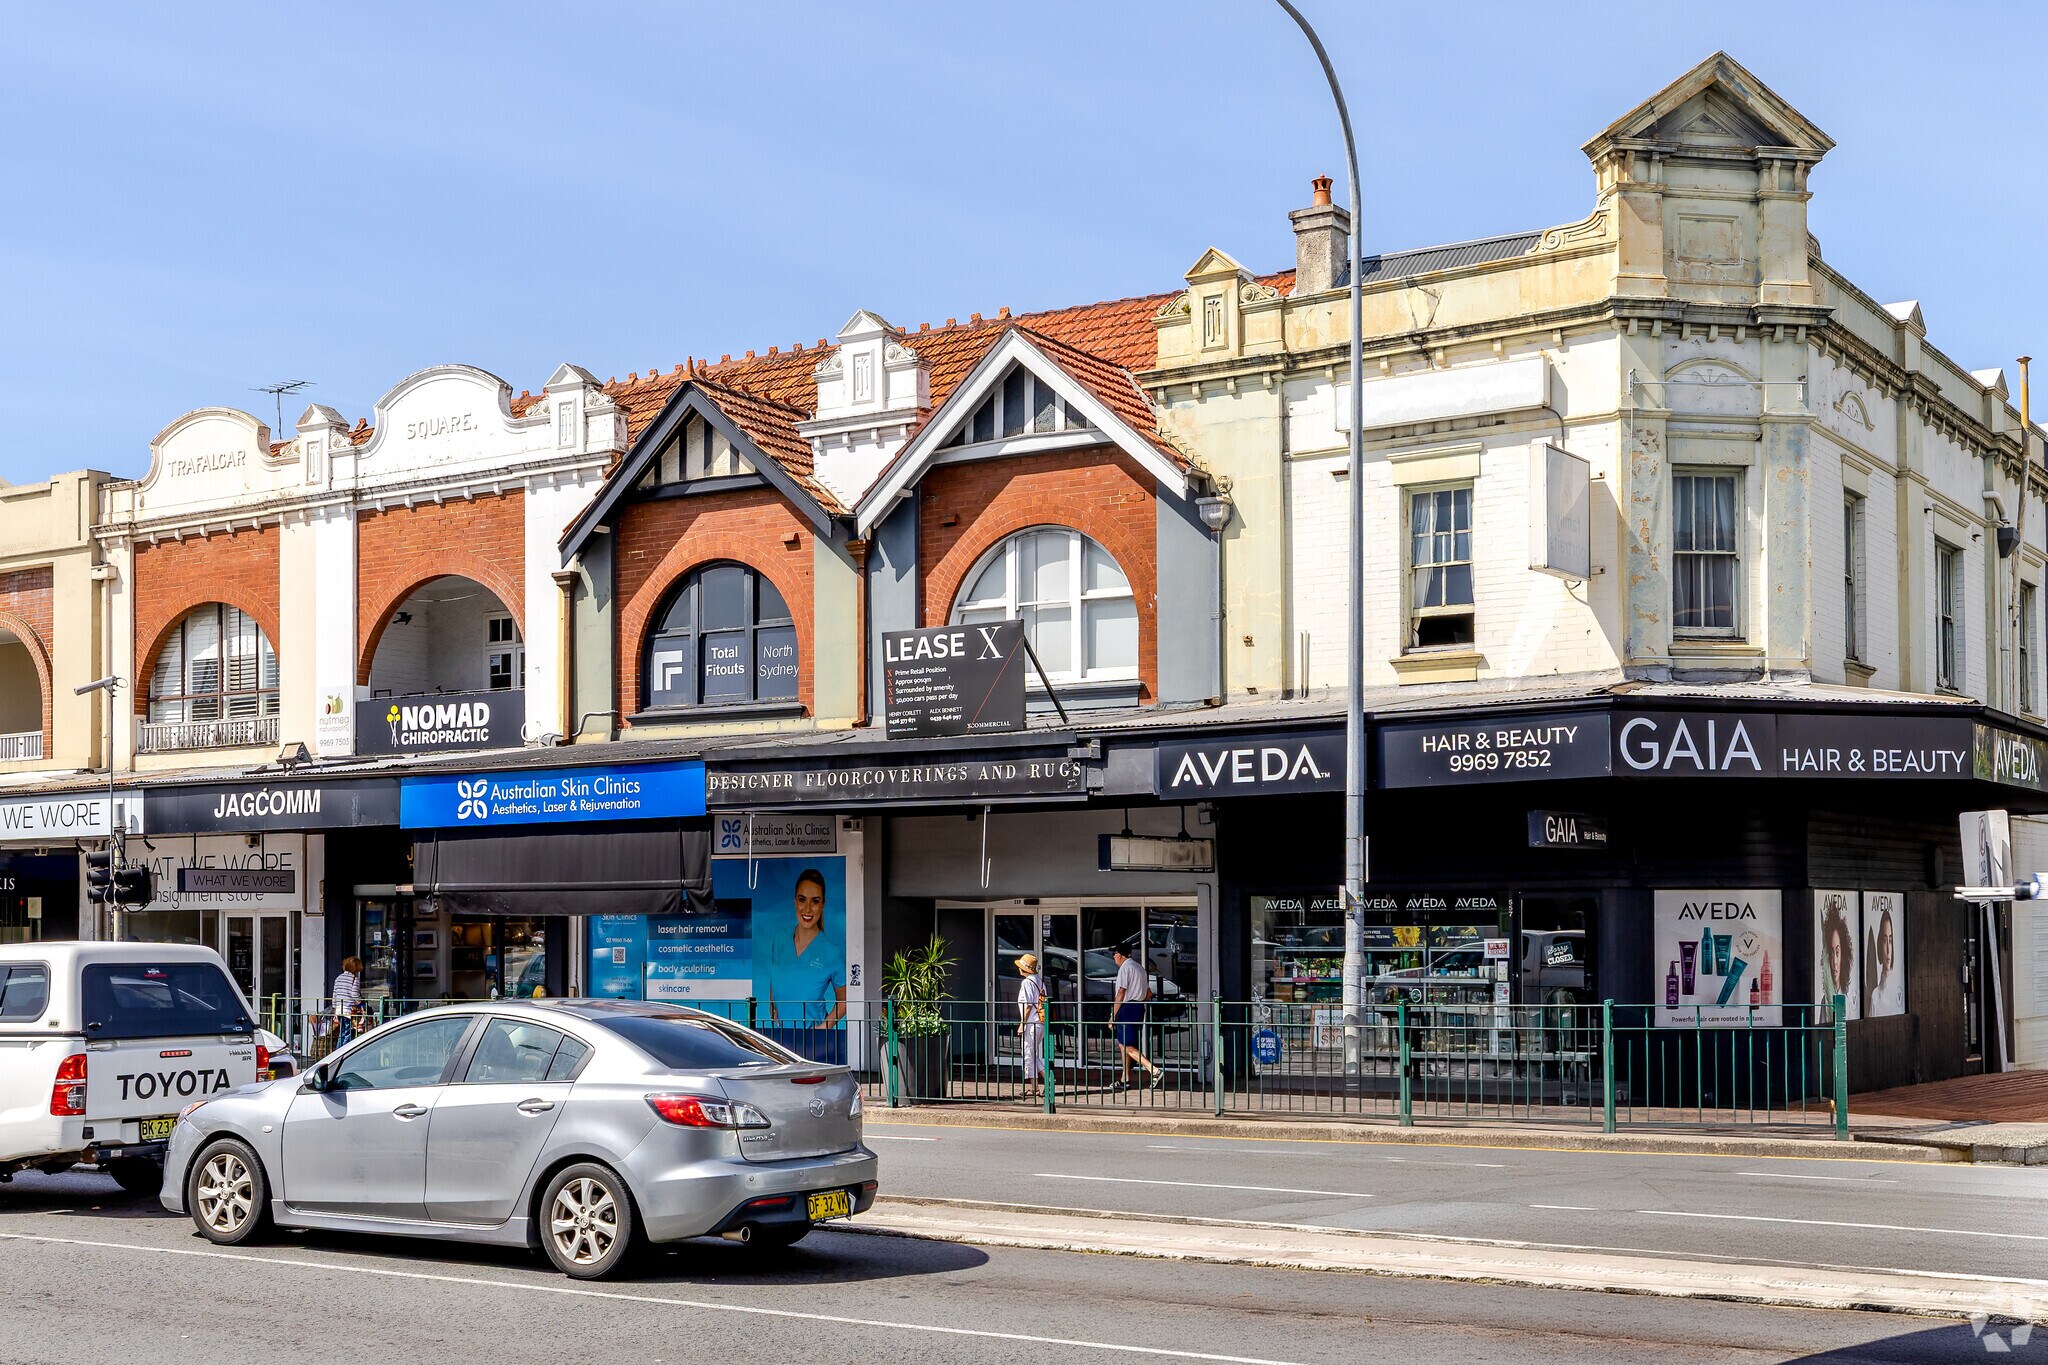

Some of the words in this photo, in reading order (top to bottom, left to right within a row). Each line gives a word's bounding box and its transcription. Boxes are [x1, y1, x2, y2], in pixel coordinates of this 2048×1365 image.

[168, 449, 247, 477] TRAFALGAR
[885, 632, 966, 663] LEASE
[976, 625, 1004, 661] X
[711, 646, 738, 659] Total
[763, 645, 793, 658] North
[706, 664, 745, 676] Fitouts
[759, 664, 799, 679] Sydney
[926, 666, 947, 674] Position
[895, 686, 925, 694] Surrounded
[926, 685, 933, 693] by
[319, 715, 350, 725] nutmeg
[401, 702, 490, 731] NOMAD
[319, 738, 335, 747] 9969
[400, 727, 490, 746] CHIROPRACTIC
[1422, 735, 1471, 753] HAIR
[1476, 732, 1490, 750] &
[1496, 726, 1578, 749] BEAUTY
[1619, 717, 1762, 771] GAIA
[1782, 747, 1842, 772] HAIR
[1847, 748, 1866, 771] &
[1874, 749, 1966, 773] BEAUTY
[1450, 751, 1500, 772] 9969
[1502, 748, 1552, 770] 7852
[709, 773, 794, 791] DESIGNER
[804, 766, 968, 788] FLOORCOVERINGS
[978, 764, 1017, 781] AND
[1029, 761, 1082, 779] RUGS
[490, 780, 556, 800] Australian
[561, 777, 589, 797] Skin
[593, 776, 641, 795] Clinics
[492, 801, 541, 815] Aesthetics,
[543, 801, 568, 813] Laser
[569, 800, 578, 811] &
[580, 798, 641, 813] Rejuvenation
[2, 804, 34, 829] WE
[40, 801, 101, 827] WORE
[785, 823, 802, 836] Skin
[803, 823, 830, 836] Clinics
[1545, 816, 1578, 843] GAIA
[775, 838, 790, 846] Laser
[797, 838, 831, 847] Rejuvenation
[223, 853, 293, 870] WORE
[0, 877, 16, 891] IS
[193, 875, 228, 887] WHAT
[230, 875, 250, 887] WE
[252, 876, 288, 887] WORE
[151, 886, 223, 909] nsignment
[1310, 899, 1340, 909] AVED
[1406, 898, 1447, 908] AVEDA
[1454, 897, 1497, 908] AVEDA
[1871, 895, 1894, 912] AVEDA
[1264, 899, 1303, 910] AVEDA
[1678, 902, 1757, 920] AVEDA
[658, 924, 677, 934] laser
[678, 924, 694, 933] hair
[695, 924, 728, 933] removal
[658, 944, 693, 953] cosmetic
[694, 943, 735, 953] aesthetics
[1547, 944, 1569, 956] Sorry
[1743, 939, 1753, 949] V
[1548, 954, 1574, 965] CLOSED
[658, 964, 679, 975] body
[680, 964, 716, 974] sculpting
[658, 984, 691, 993] skincare
[117, 1068, 231, 1101] TOYOTA
